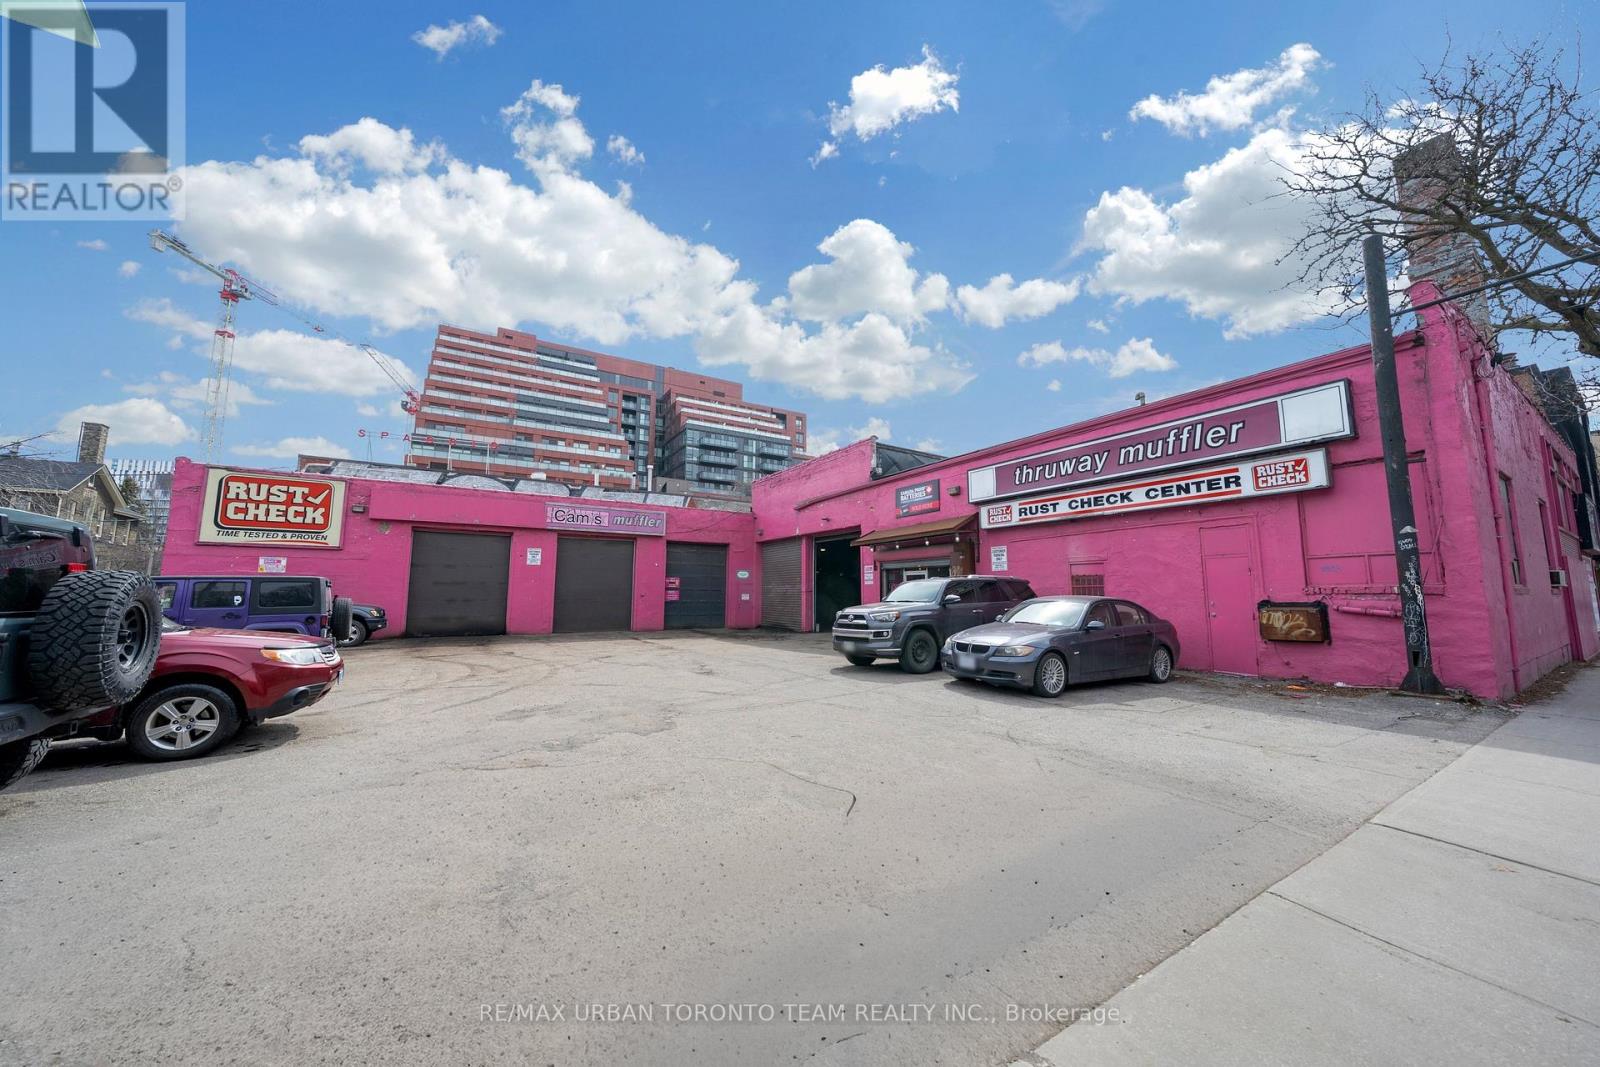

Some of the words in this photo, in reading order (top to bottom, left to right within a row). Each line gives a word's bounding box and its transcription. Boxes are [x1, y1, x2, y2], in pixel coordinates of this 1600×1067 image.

[1014, 449, 1109, 485] thruway
[1118, 420, 1245, 465] muffler
[1256, 461, 1295, 477] RUST
[1258, 470, 1307, 488] CHECK
[226, 481, 309, 504] RUST
[1018, 502, 1059, 517] RUST
[1068, 491, 1133, 510] CHECK
[1144, 475, 1242, 500] CENTER
[226, 502, 325, 525] CHECK
[989, 507, 1006, 516] RUST
[989, 514, 1012, 524] CHECK
[613, 514, 662, 528] muffler
[217, 530, 240, 538] TIME
[243, 531, 279, 539] TESTED
[290, 533, 328, 541] PROVEN
